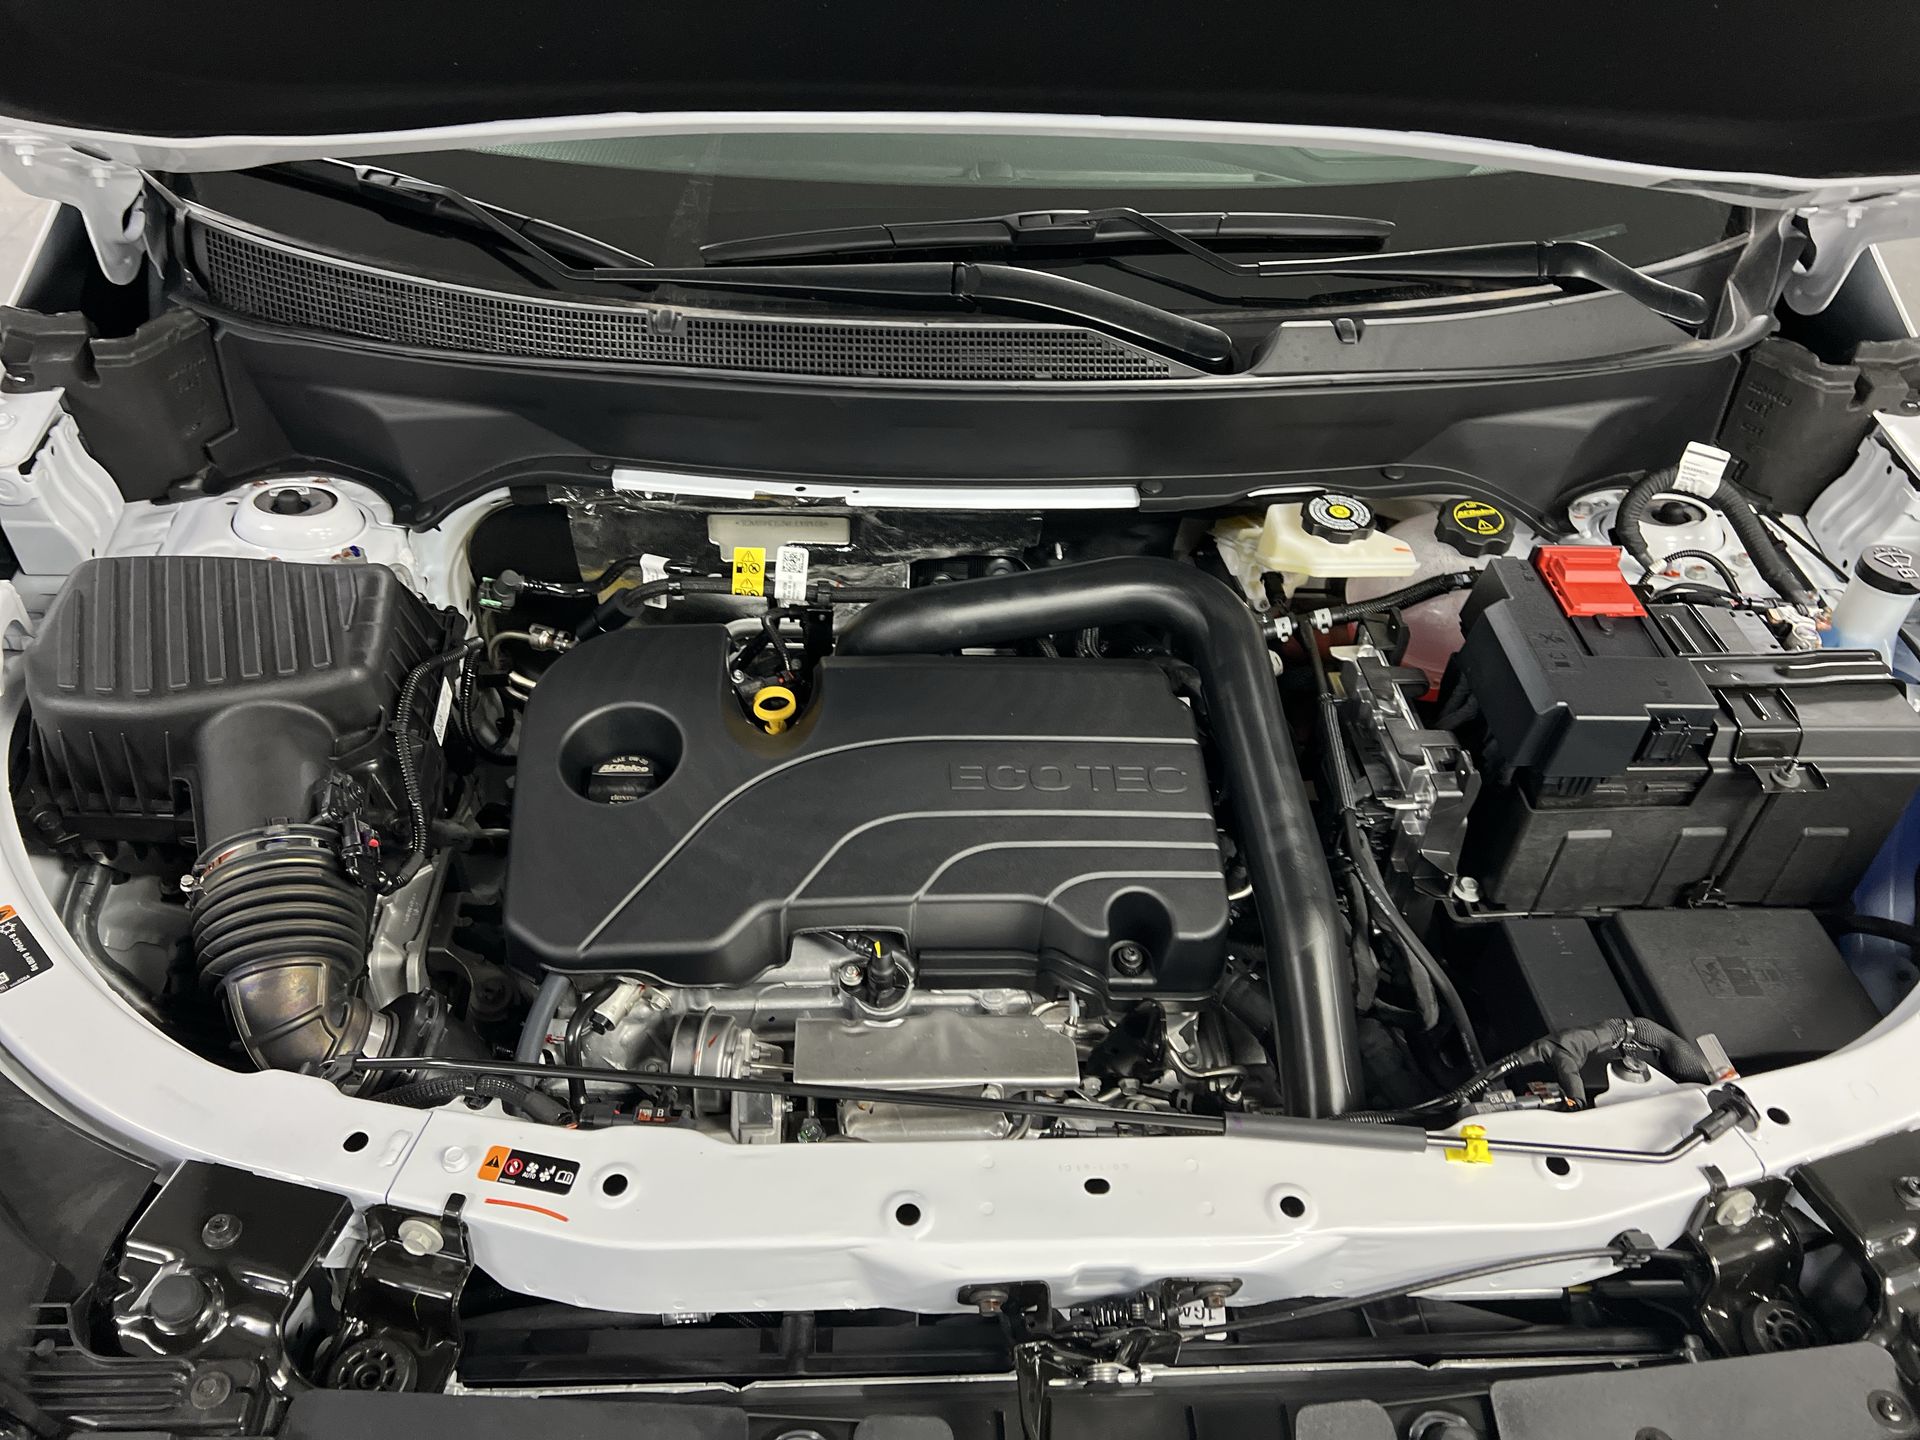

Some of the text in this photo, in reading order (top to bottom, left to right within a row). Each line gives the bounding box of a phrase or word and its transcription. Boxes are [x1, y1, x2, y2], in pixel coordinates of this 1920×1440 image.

[598, 764, 649, 774] ACDelco
[951, 763, 1188, 795] ECOTEC
[522, 1171, 537, 1180] AUTO
